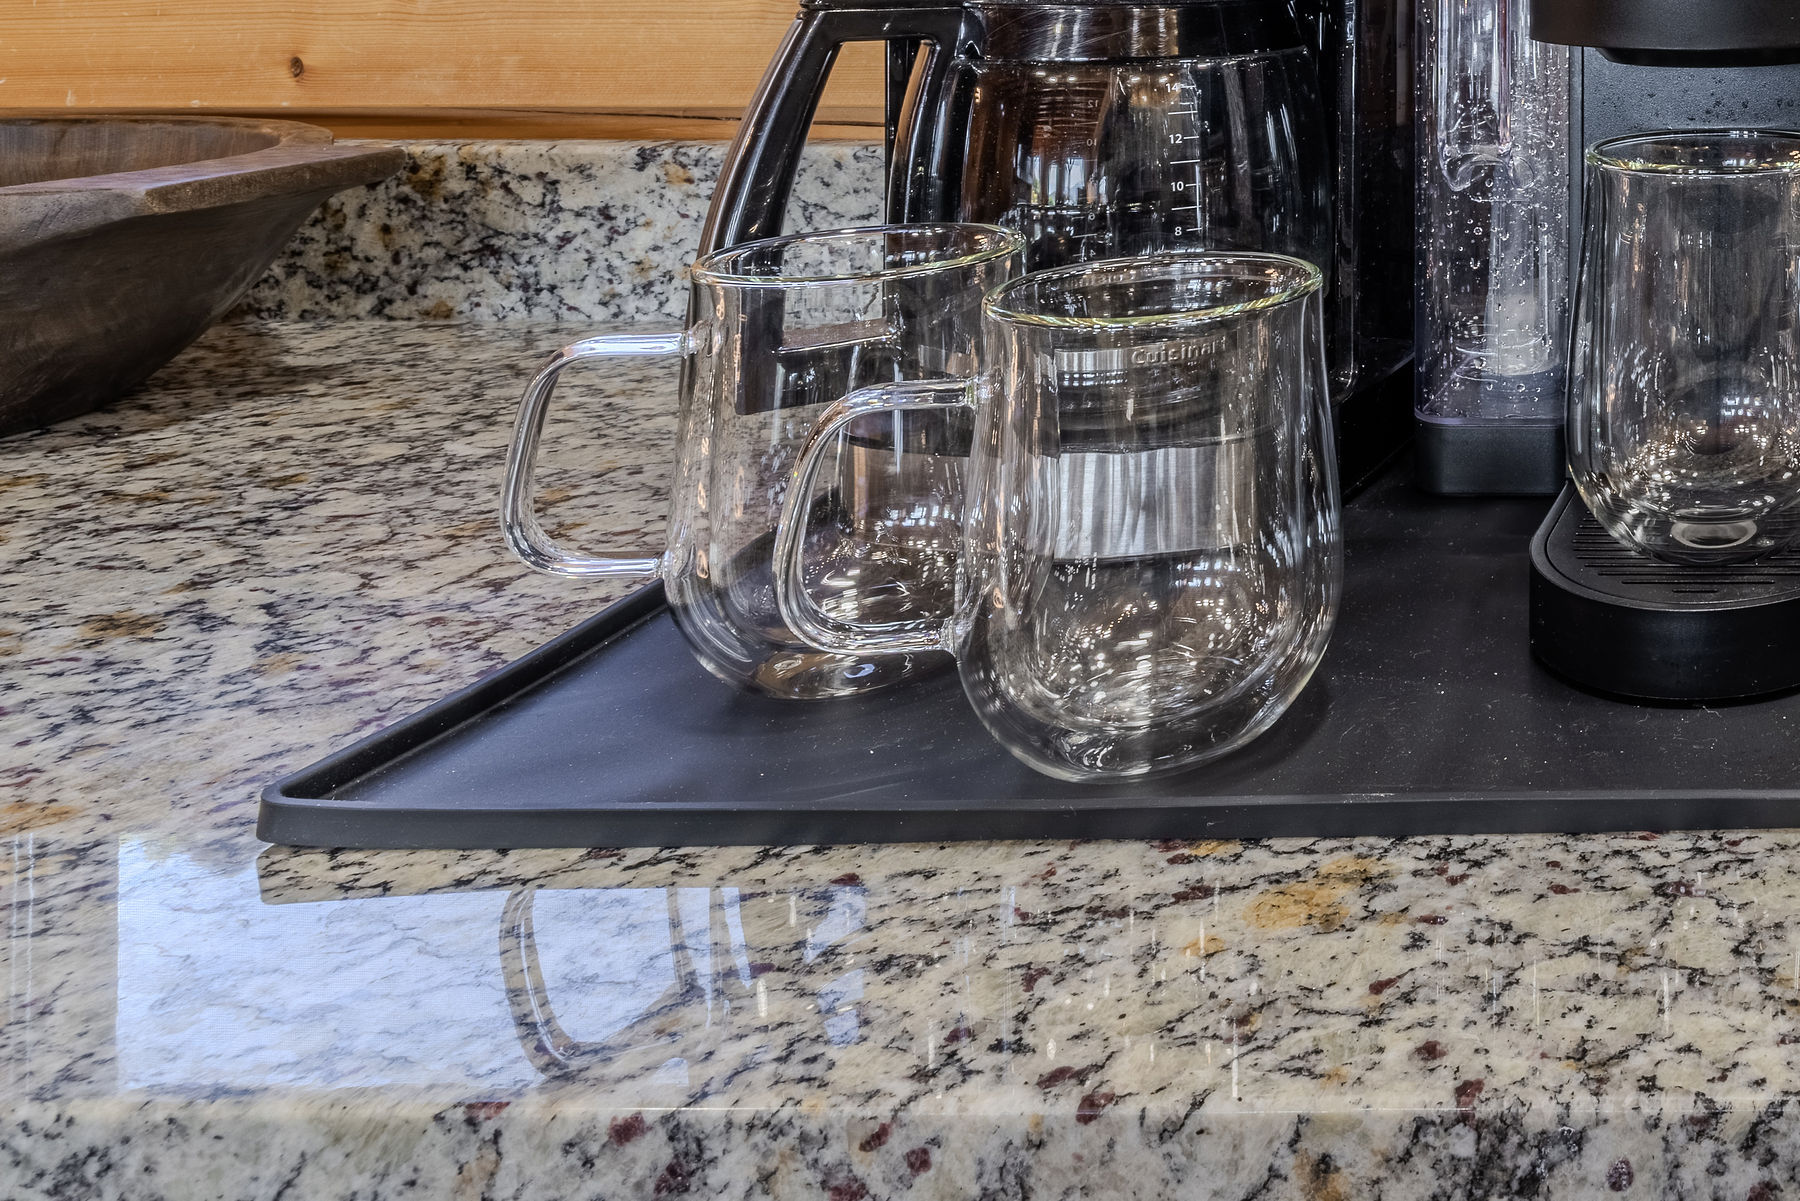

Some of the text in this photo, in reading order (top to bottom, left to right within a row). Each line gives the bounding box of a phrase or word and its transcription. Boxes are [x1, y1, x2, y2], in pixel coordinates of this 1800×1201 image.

[1165, 82, 1180, 93] 14
[1168, 133, 1183, 144] 12
[1170, 181, 1184, 192] 10
[1174, 226, 1182, 236] 8
